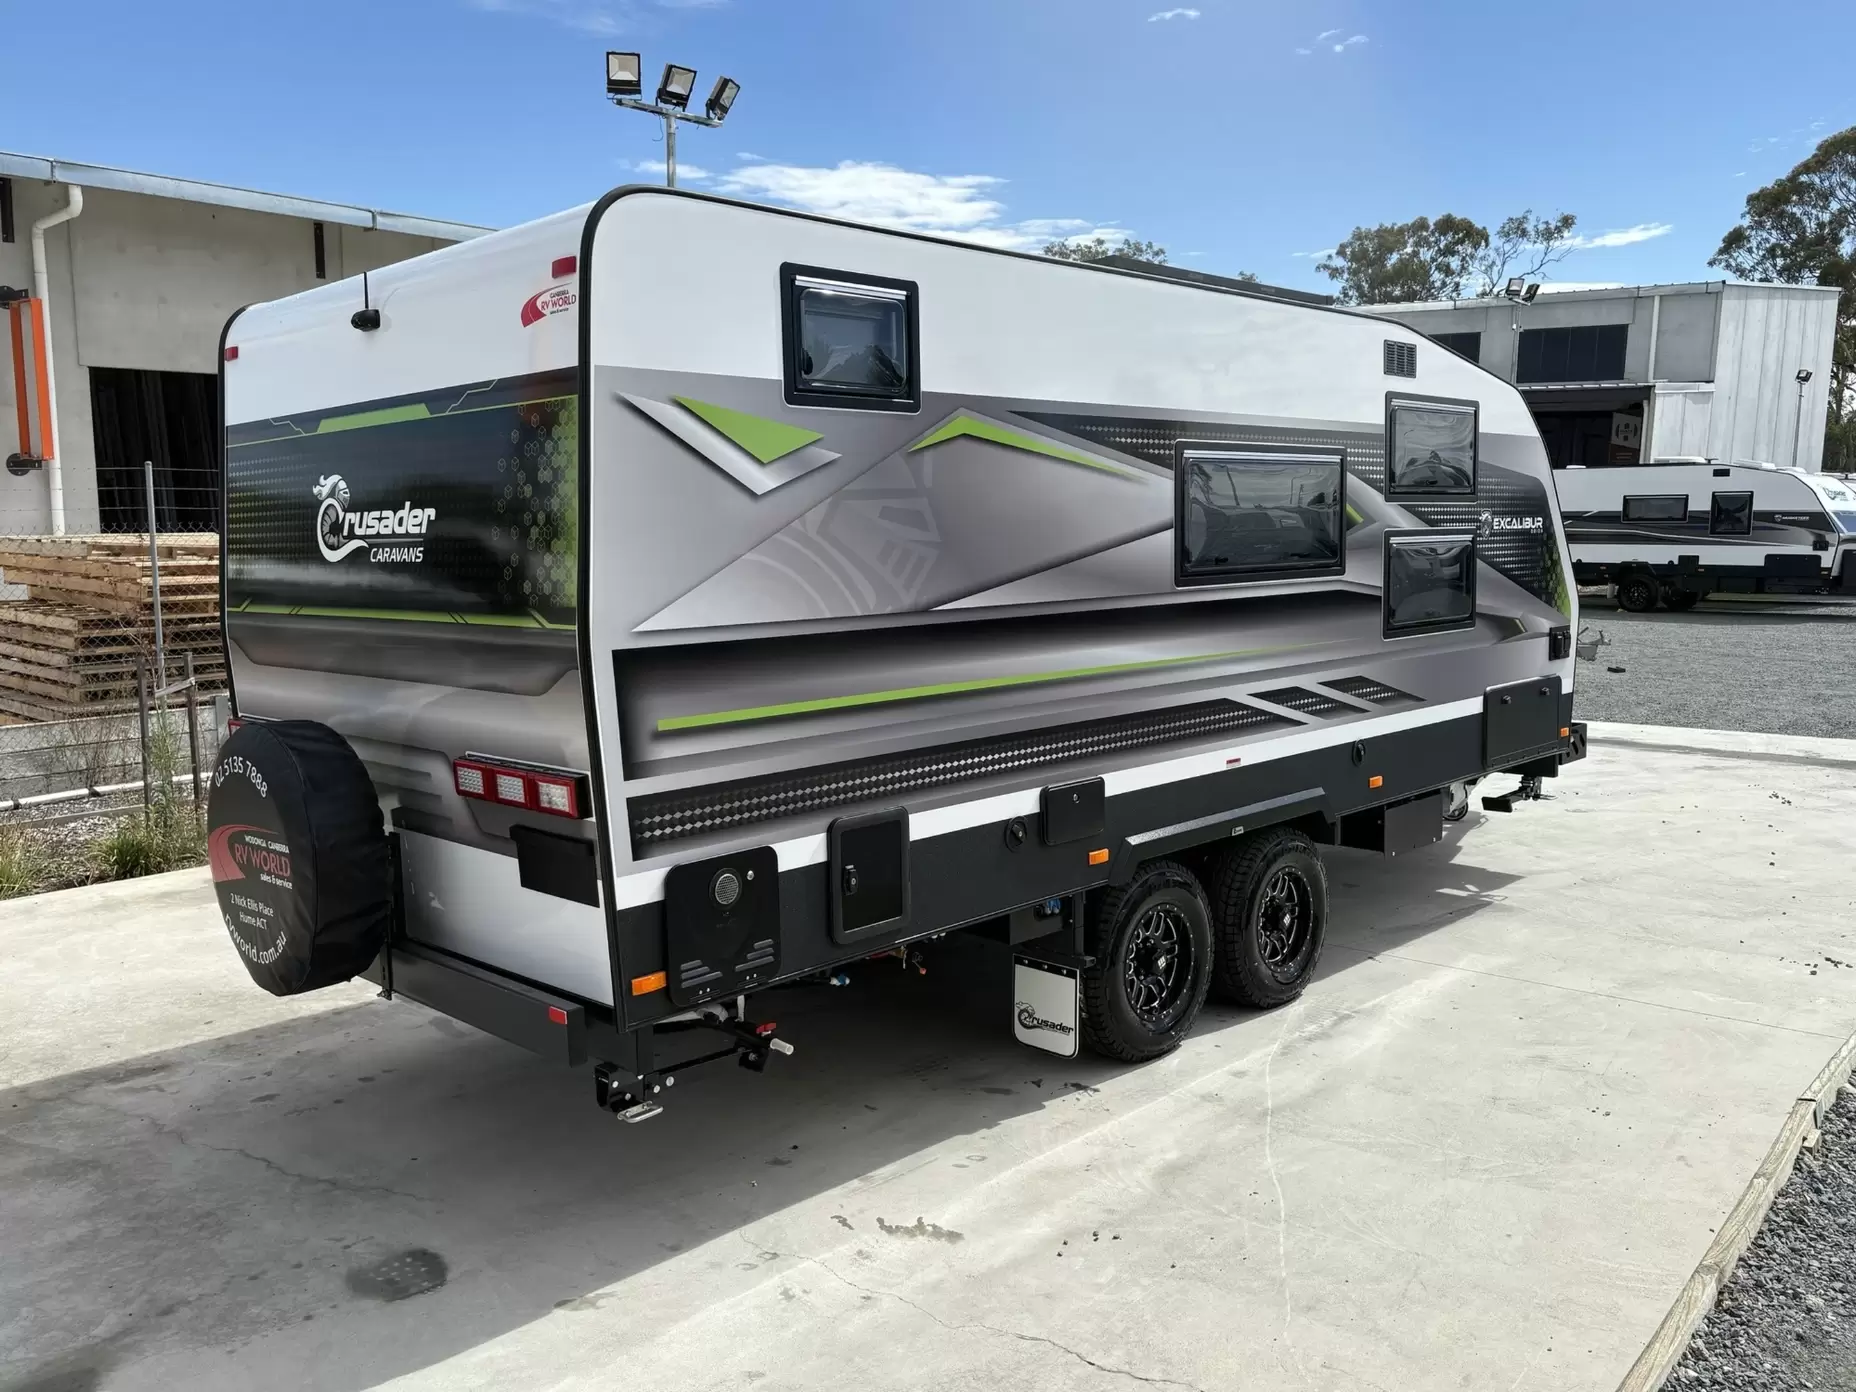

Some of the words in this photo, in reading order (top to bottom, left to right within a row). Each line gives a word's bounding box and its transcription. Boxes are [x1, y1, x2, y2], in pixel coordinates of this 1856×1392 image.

[541, 300, 550, 311] RV
[551, 294, 576, 308] WORLD
[317, 498, 436, 563] Crusader
[1493, 517, 1543, 529] EXCALIBUR
[370, 547, 424, 563] CARAVANS
[215, 765, 225, 787] 02
[224, 756, 244, 776] 5135
[246, 760, 268, 798] 7888
[234, 843, 248, 865] RV
[249, 846, 291, 877] WORLD
[260, 872, 272, 883] sales
[275, 878, 293, 890] service
[230, 892, 235, 904] 2
[234, 894, 247, 908] Nick
[247, 898, 259, 912] Ellis
[258, 901, 274, 917] Place
[239, 911, 256, 926] Hume
[256, 917, 267, 930] ACT
[1017, 1008, 1074, 1034] Crusader
